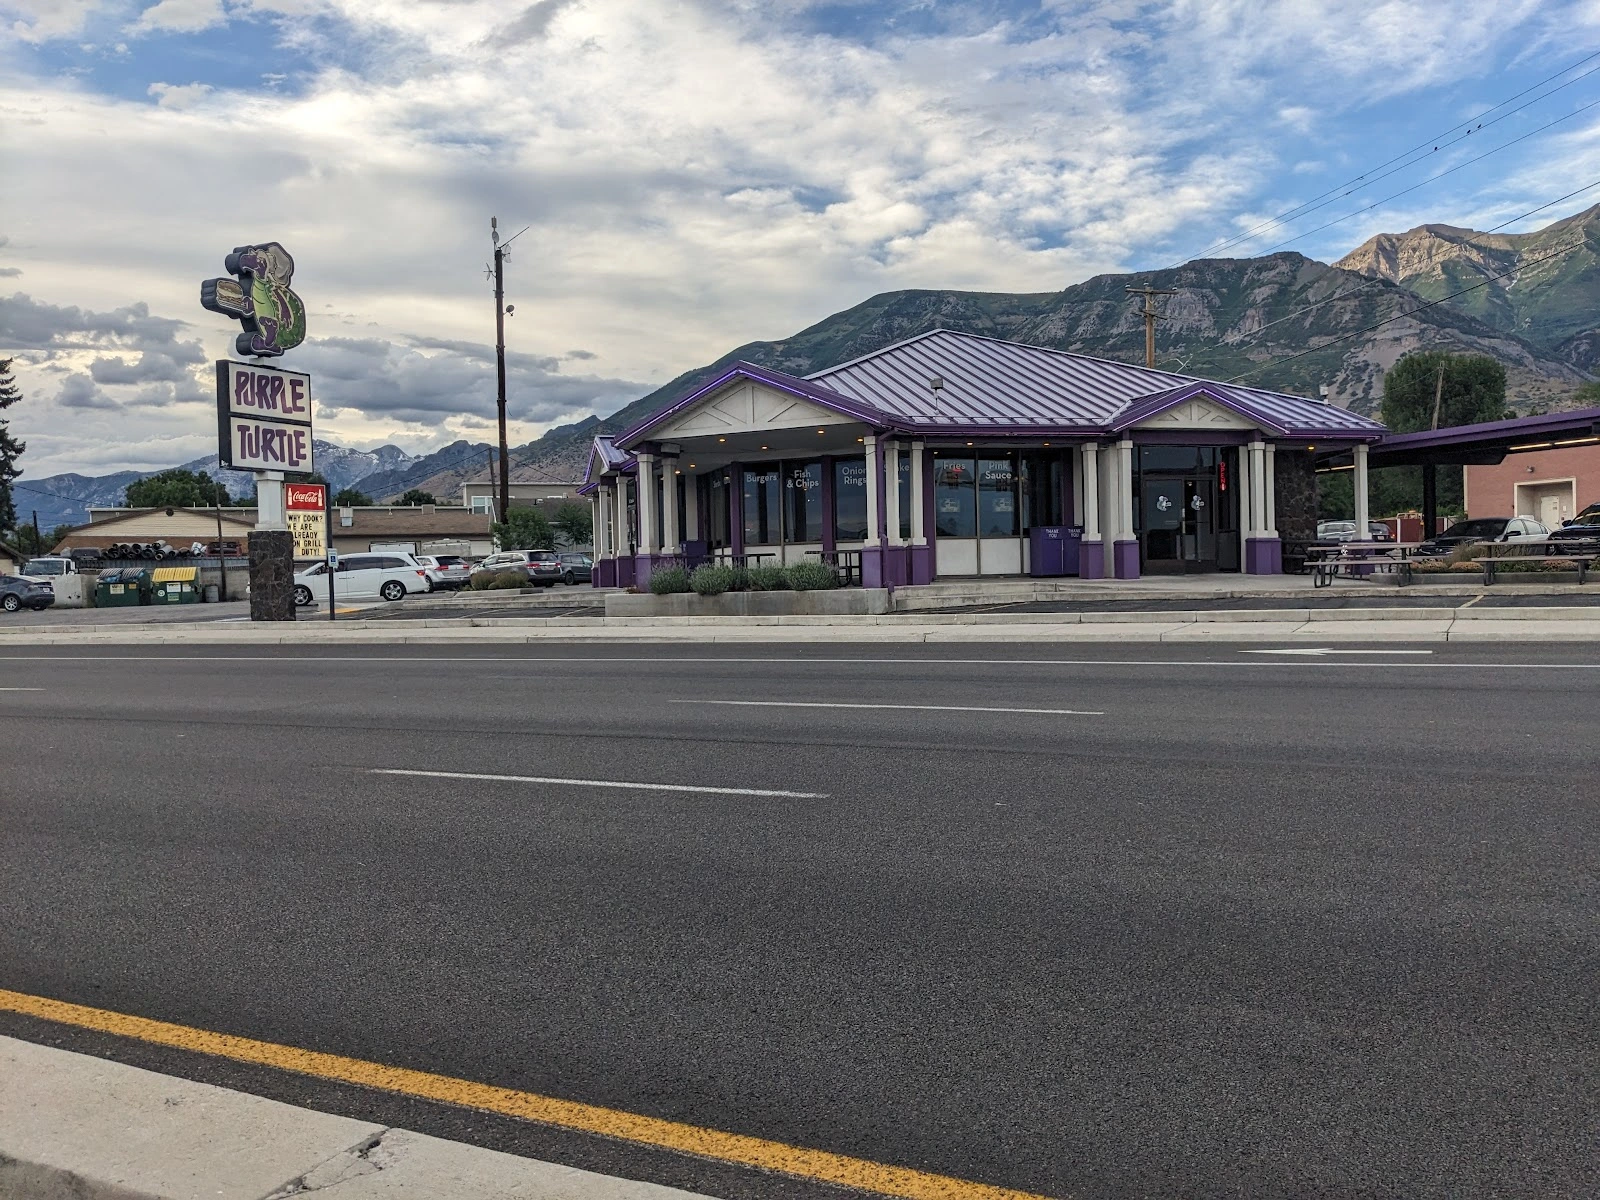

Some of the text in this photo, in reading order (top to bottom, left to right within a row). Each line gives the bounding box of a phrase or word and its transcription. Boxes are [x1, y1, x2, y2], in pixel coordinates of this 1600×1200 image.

[234, 371, 305, 414] PURPLE
[236, 424, 307, 467] TURTLE
[943, 460, 966, 470] Fries
[989, 460, 1008, 470] Pink
[746, 474, 777, 484] Burgers
[794, 469, 811, 479] Fish
[985, 470, 1012, 480] Sauce
[786, 479, 819, 489] & Chips
[844, 475, 867, 486] Rings
[288, 514, 323, 522] WHY COOK?
[300, 523, 313, 531] ARE
[293, 531, 318, 539] LREADY
[303, 540, 323, 548] GRILL
[301, 548, 320, 556] DUTY!
